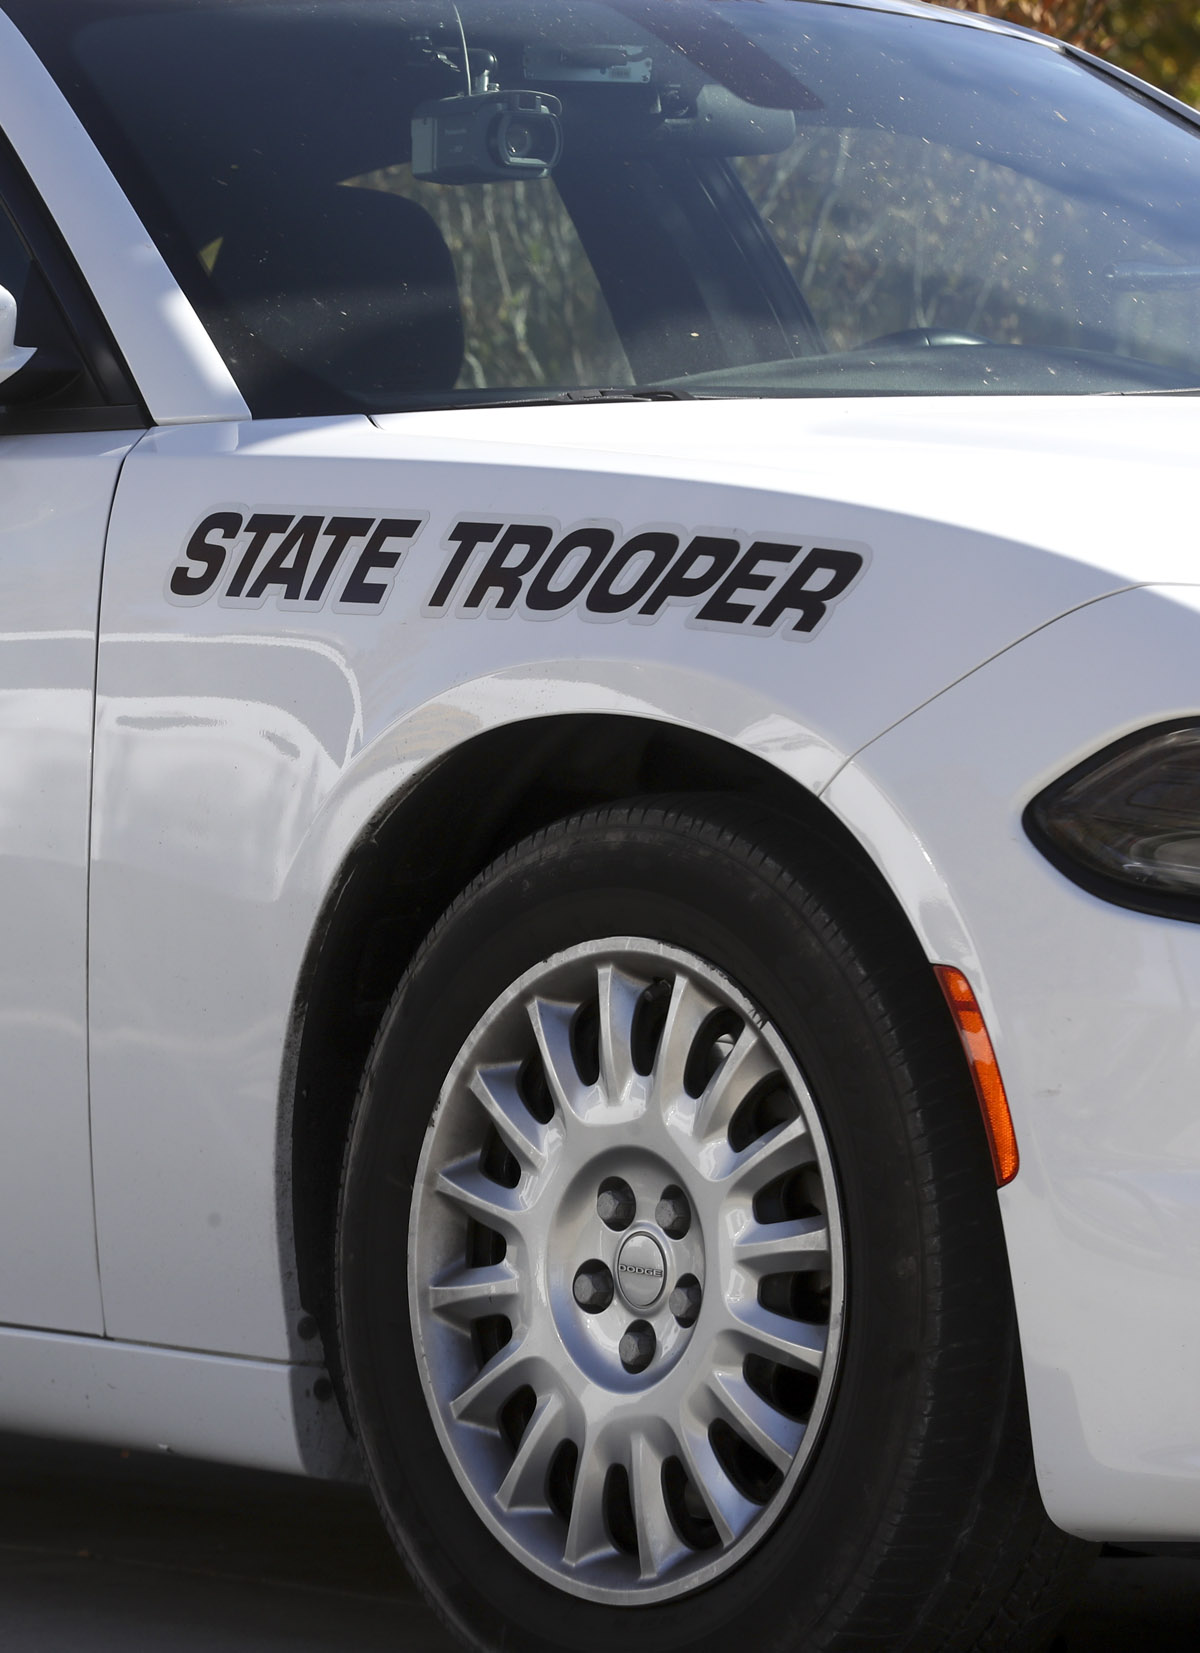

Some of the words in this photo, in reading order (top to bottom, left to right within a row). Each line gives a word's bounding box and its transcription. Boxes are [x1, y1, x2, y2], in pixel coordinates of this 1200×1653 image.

[169, 511, 422, 605] STATE
[427, 521, 864, 633] TROOPER
[619, 1264, 663, 1277] DODGE
